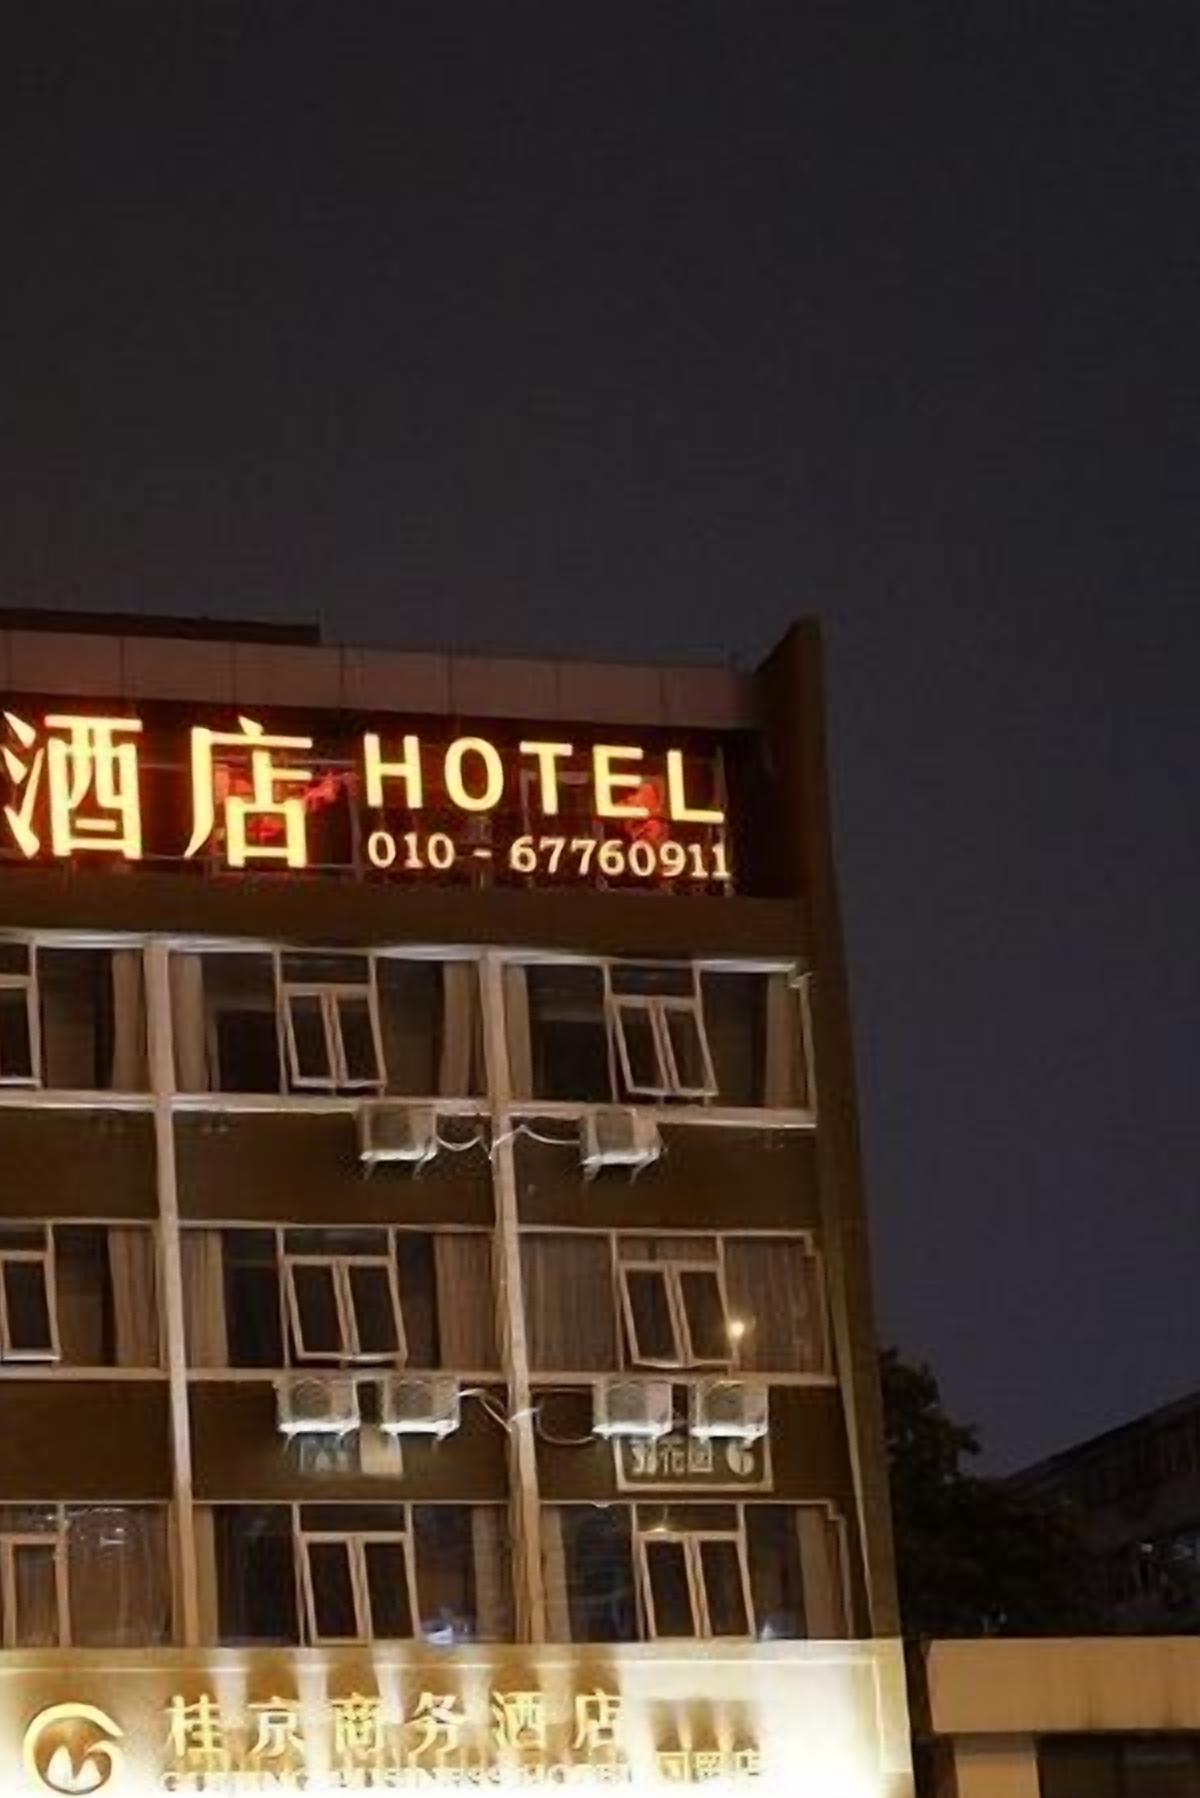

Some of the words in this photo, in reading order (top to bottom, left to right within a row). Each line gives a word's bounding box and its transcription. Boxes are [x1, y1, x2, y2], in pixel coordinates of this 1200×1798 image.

[363, 732, 725, 824] HOTEL
[164, 1688, 625, 1757] 桂京商务酒店
